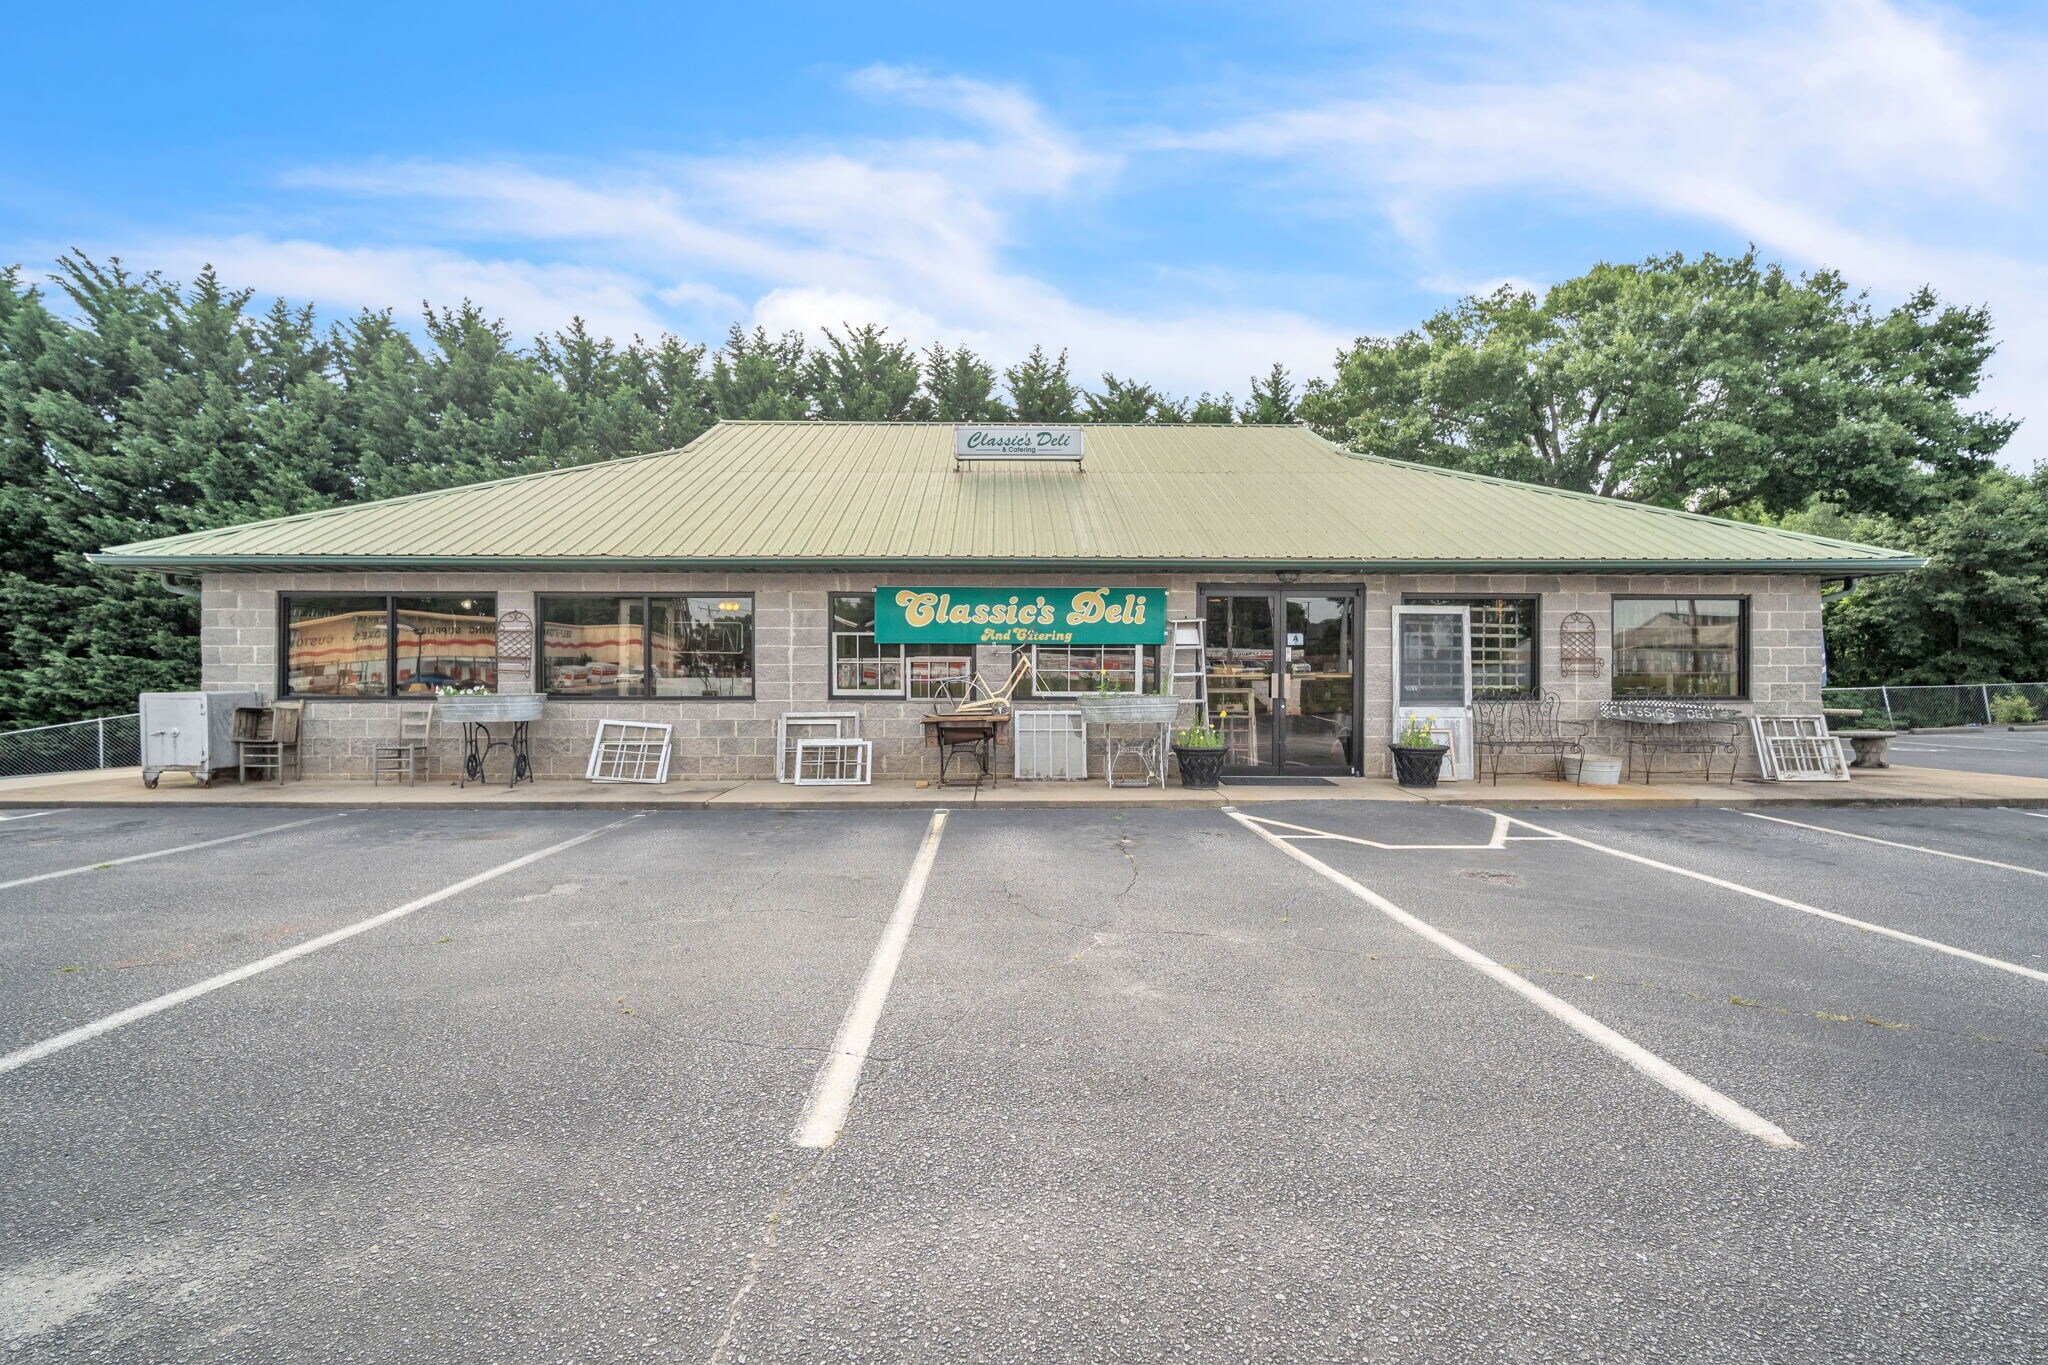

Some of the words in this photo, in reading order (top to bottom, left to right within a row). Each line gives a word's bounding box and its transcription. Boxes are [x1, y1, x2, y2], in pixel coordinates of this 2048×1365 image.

[967, 431, 1032, 448] Classic's
[1036, 431, 1070, 446] Deli
[895, 590, 1055, 627] Classic's
[1066, 587, 1147, 625] Deli
[980, 627, 1012, 641] And
